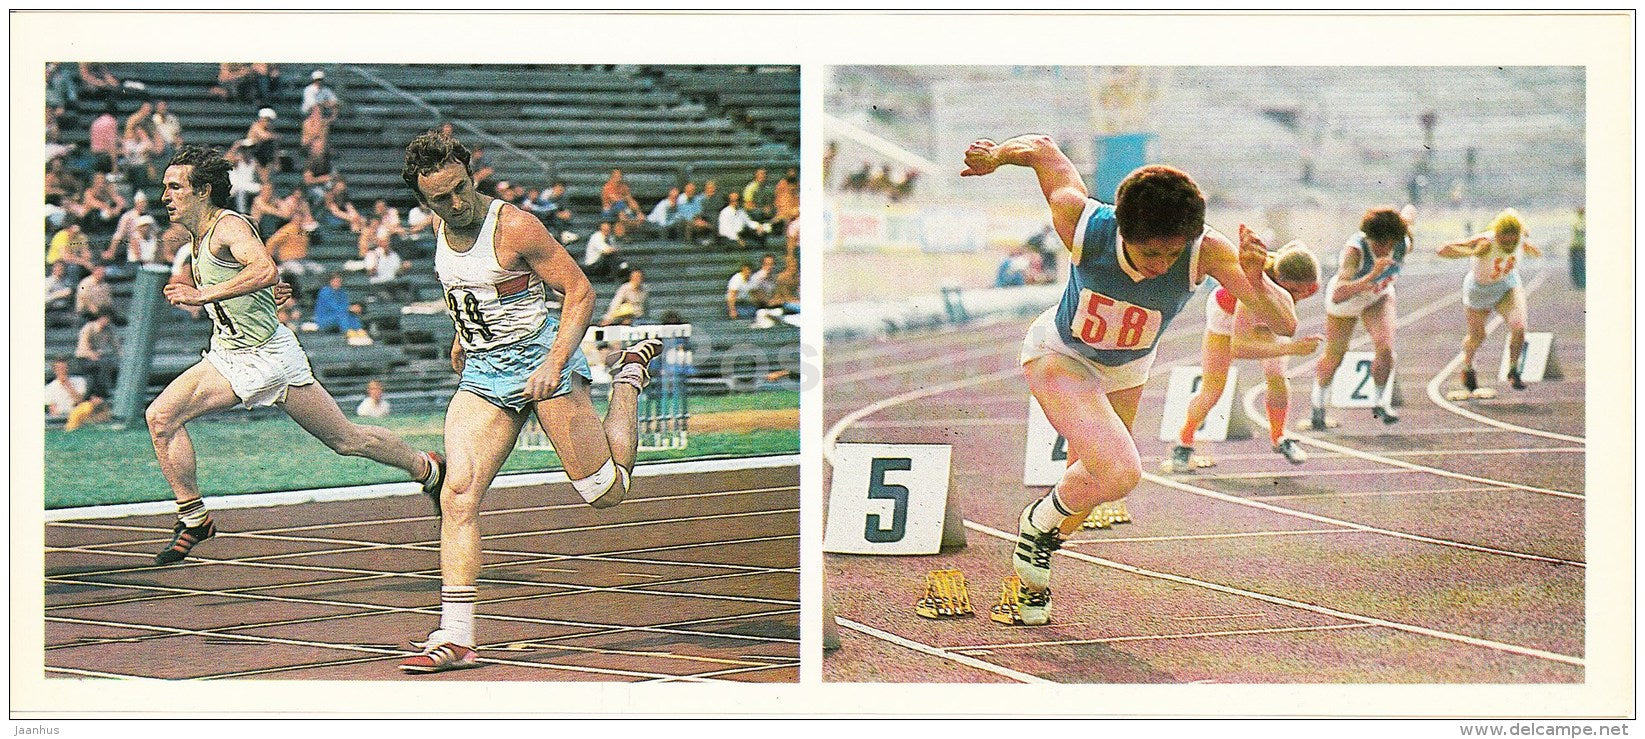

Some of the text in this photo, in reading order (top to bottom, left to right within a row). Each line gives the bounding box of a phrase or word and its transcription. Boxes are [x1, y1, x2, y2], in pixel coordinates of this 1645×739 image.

[1081, 293, 1148, 348] 58
[1351, 360, 1372, 400] 2
[864, 457, 912, 543] 5
